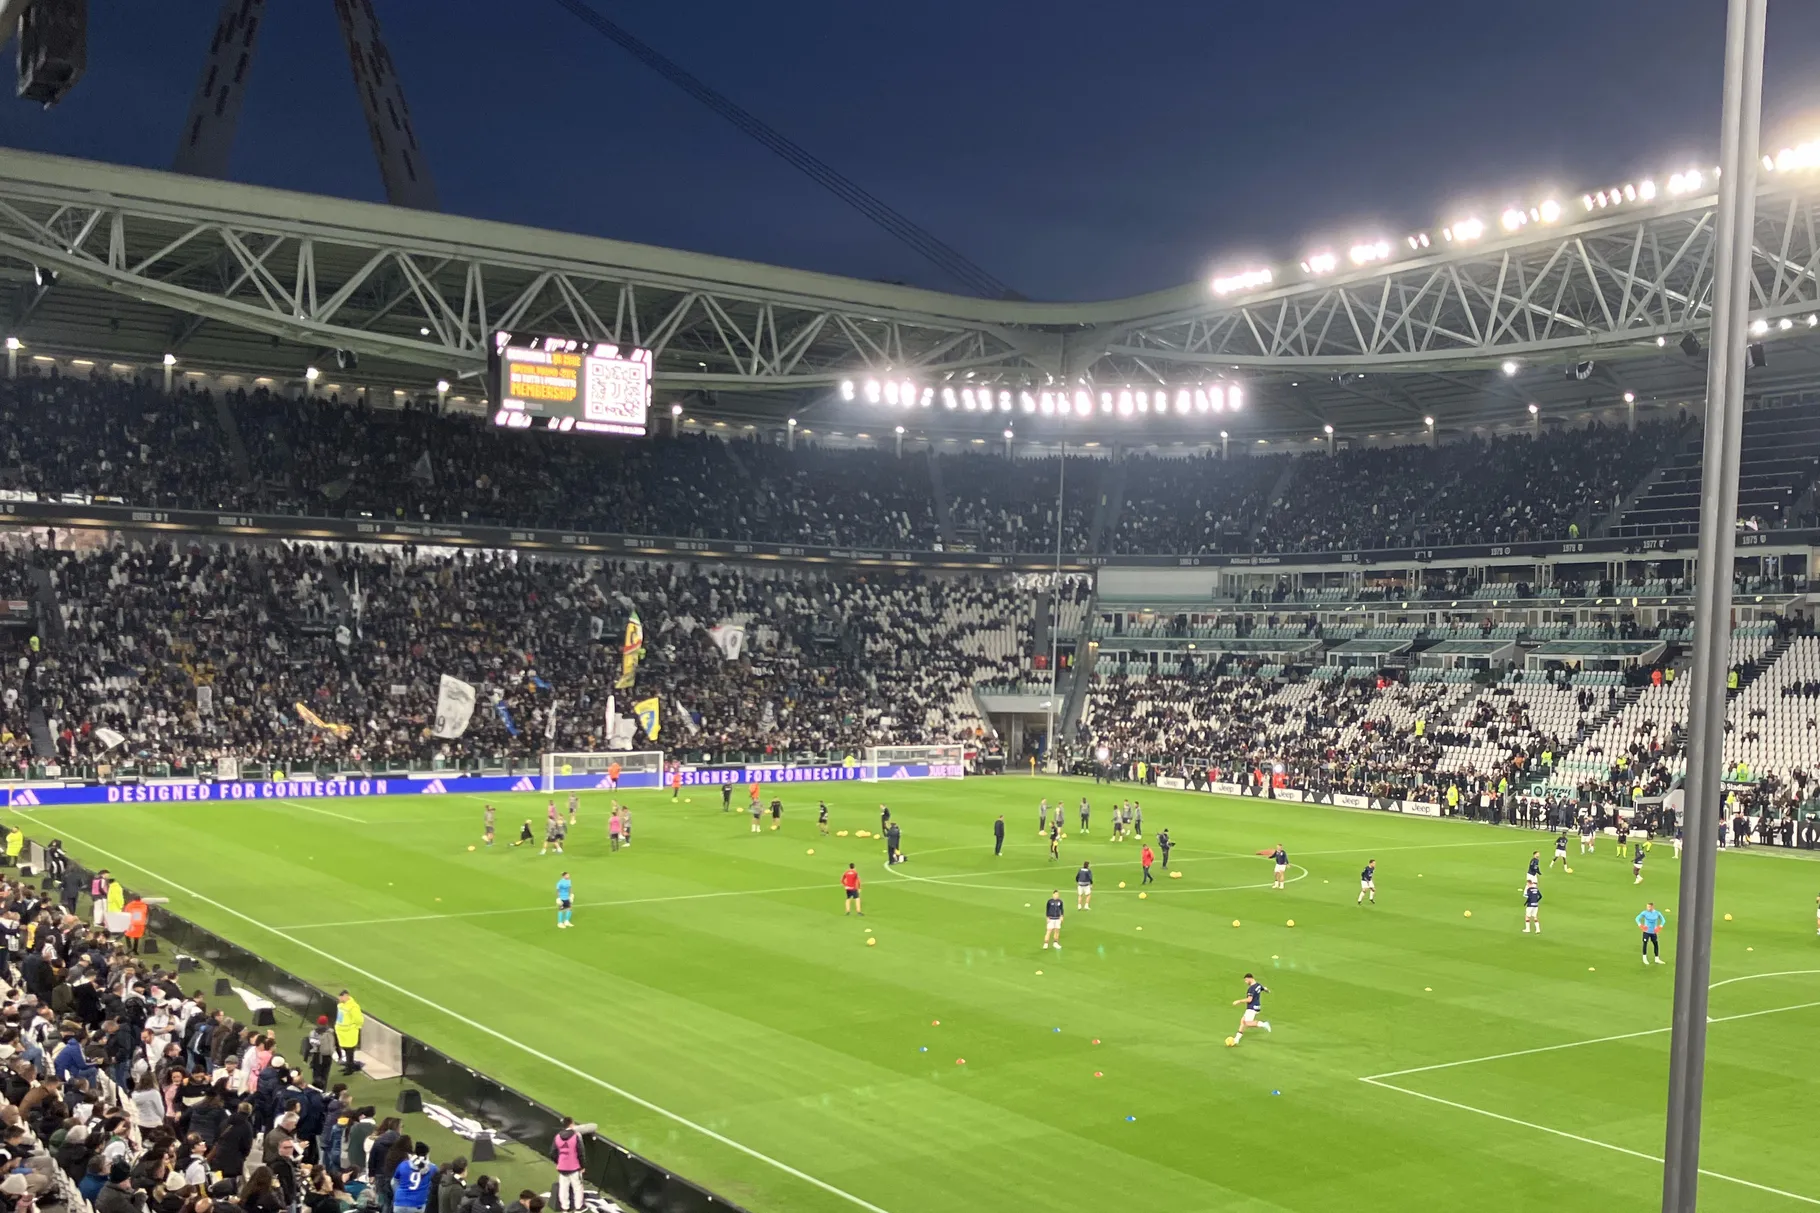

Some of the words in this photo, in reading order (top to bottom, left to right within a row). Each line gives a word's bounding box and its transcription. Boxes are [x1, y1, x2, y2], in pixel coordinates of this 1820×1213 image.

[510, 382, 577, 401] MEMBERSHIP
[745, 770, 772, 782] FOR
[775, 767, 867, 782] CONNECTION
[108, 784, 210, 802] DESIGNED
[220, 782, 256, 799] FOR
[262, 780, 387, 798] CONNECTION
[1218, 784, 1234, 793] Jeep
[1277, 789, 1295, 799] Jeep
[1341, 796, 1360, 806] Jeep
[1412, 803, 1430, 814] Jeep
[409, 1171, 421, 1190] 9
